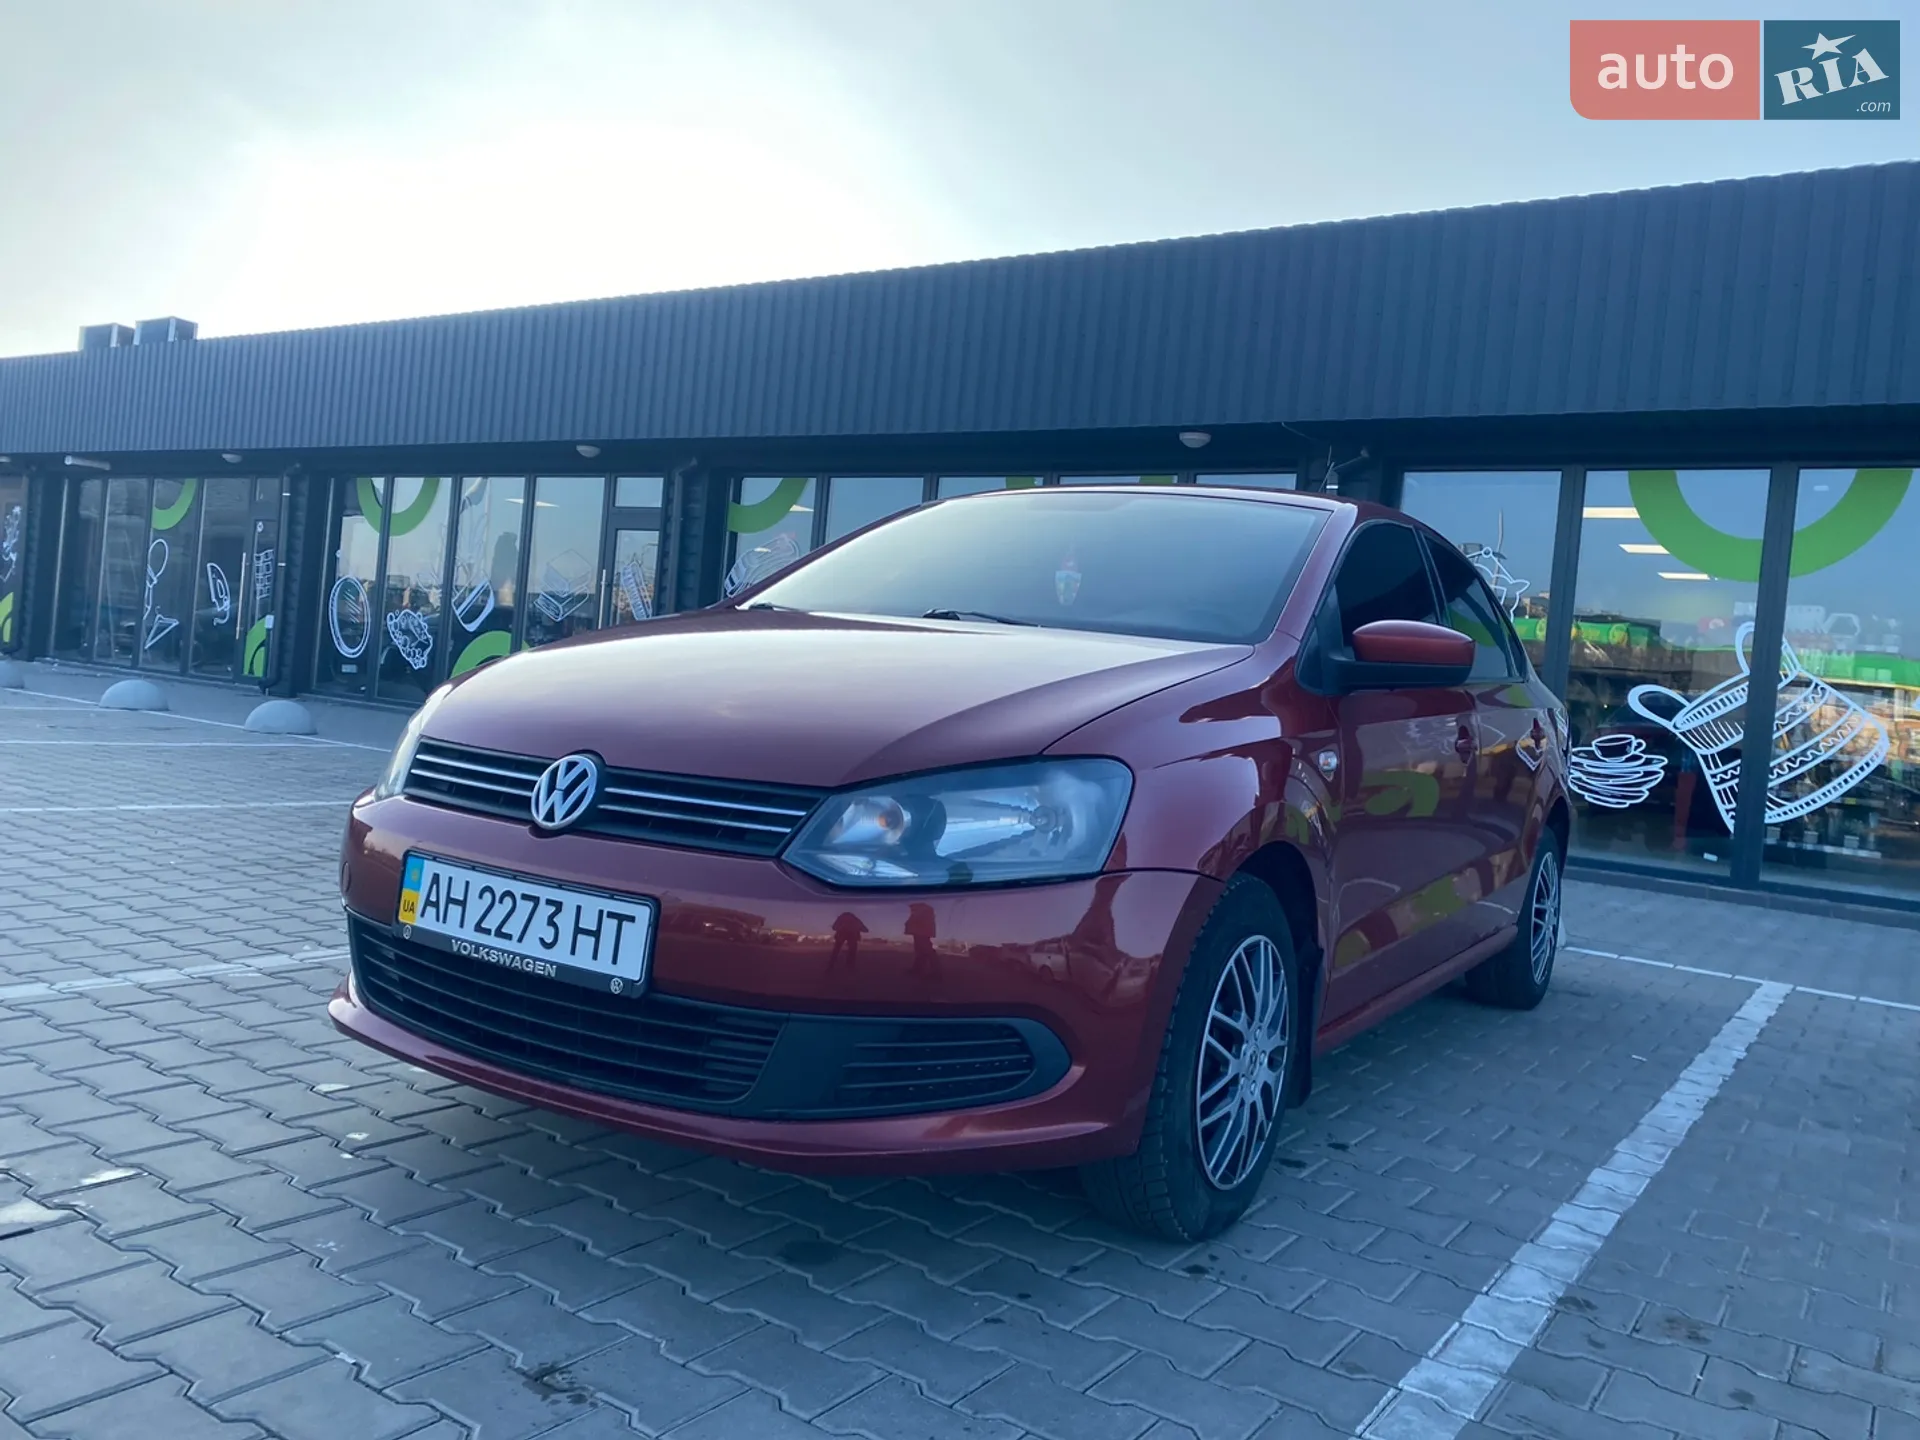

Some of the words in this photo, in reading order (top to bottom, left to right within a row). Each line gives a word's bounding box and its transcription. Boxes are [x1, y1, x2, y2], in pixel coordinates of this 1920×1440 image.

[402, 899, 416, 914] UA
[420, 872, 470, 929] AH
[473, 885, 563, 950] 2273
[570, 904, 636, 966] HT
[451, 938, 556, 978] VOLKSWAGEN
